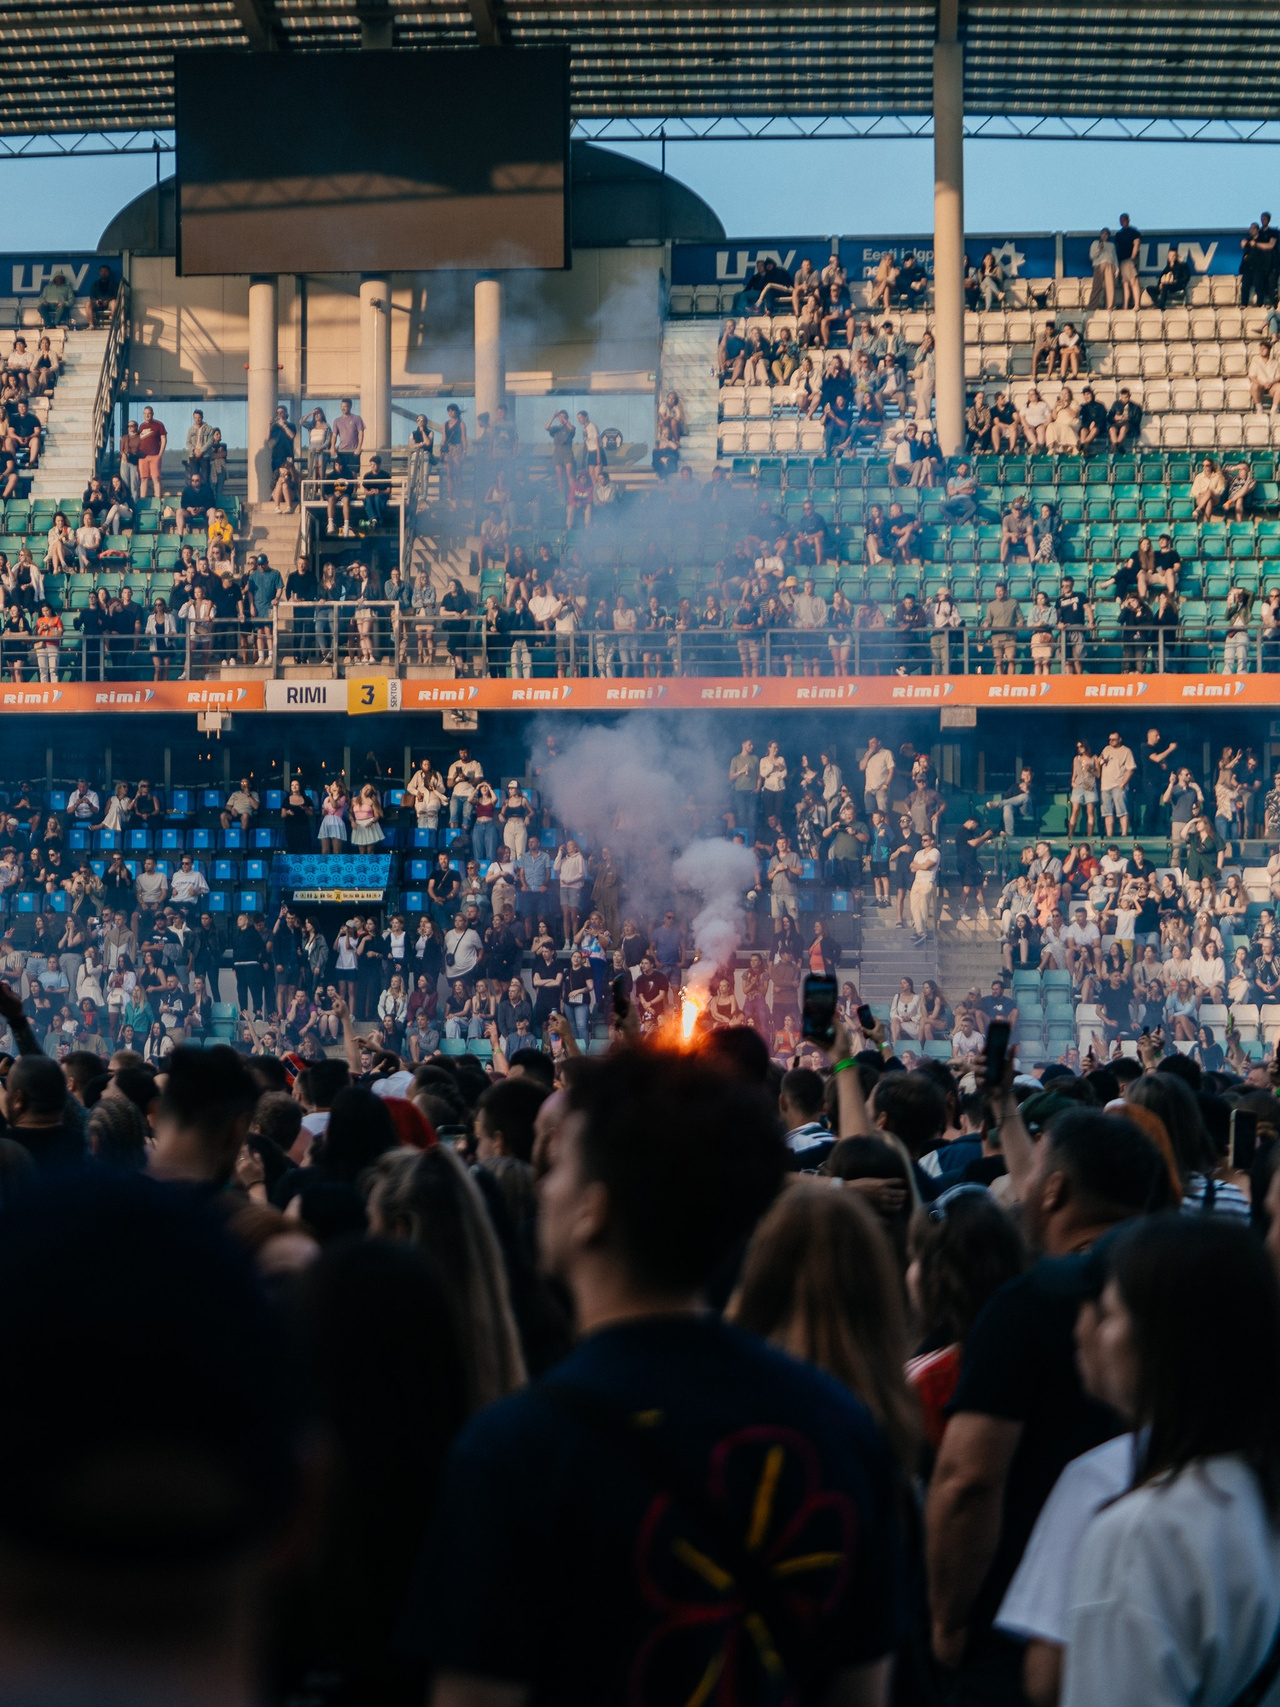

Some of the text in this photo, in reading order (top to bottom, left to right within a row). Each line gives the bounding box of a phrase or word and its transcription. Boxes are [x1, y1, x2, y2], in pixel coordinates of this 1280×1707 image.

[716, 249, 797, 279] LHV
[12, 263, 89, 293] LHV
[286, 686, 327, 704] RIMI
[361, 684, 375, 705] 3
[390, 681, 398, 708] SEKTOR
